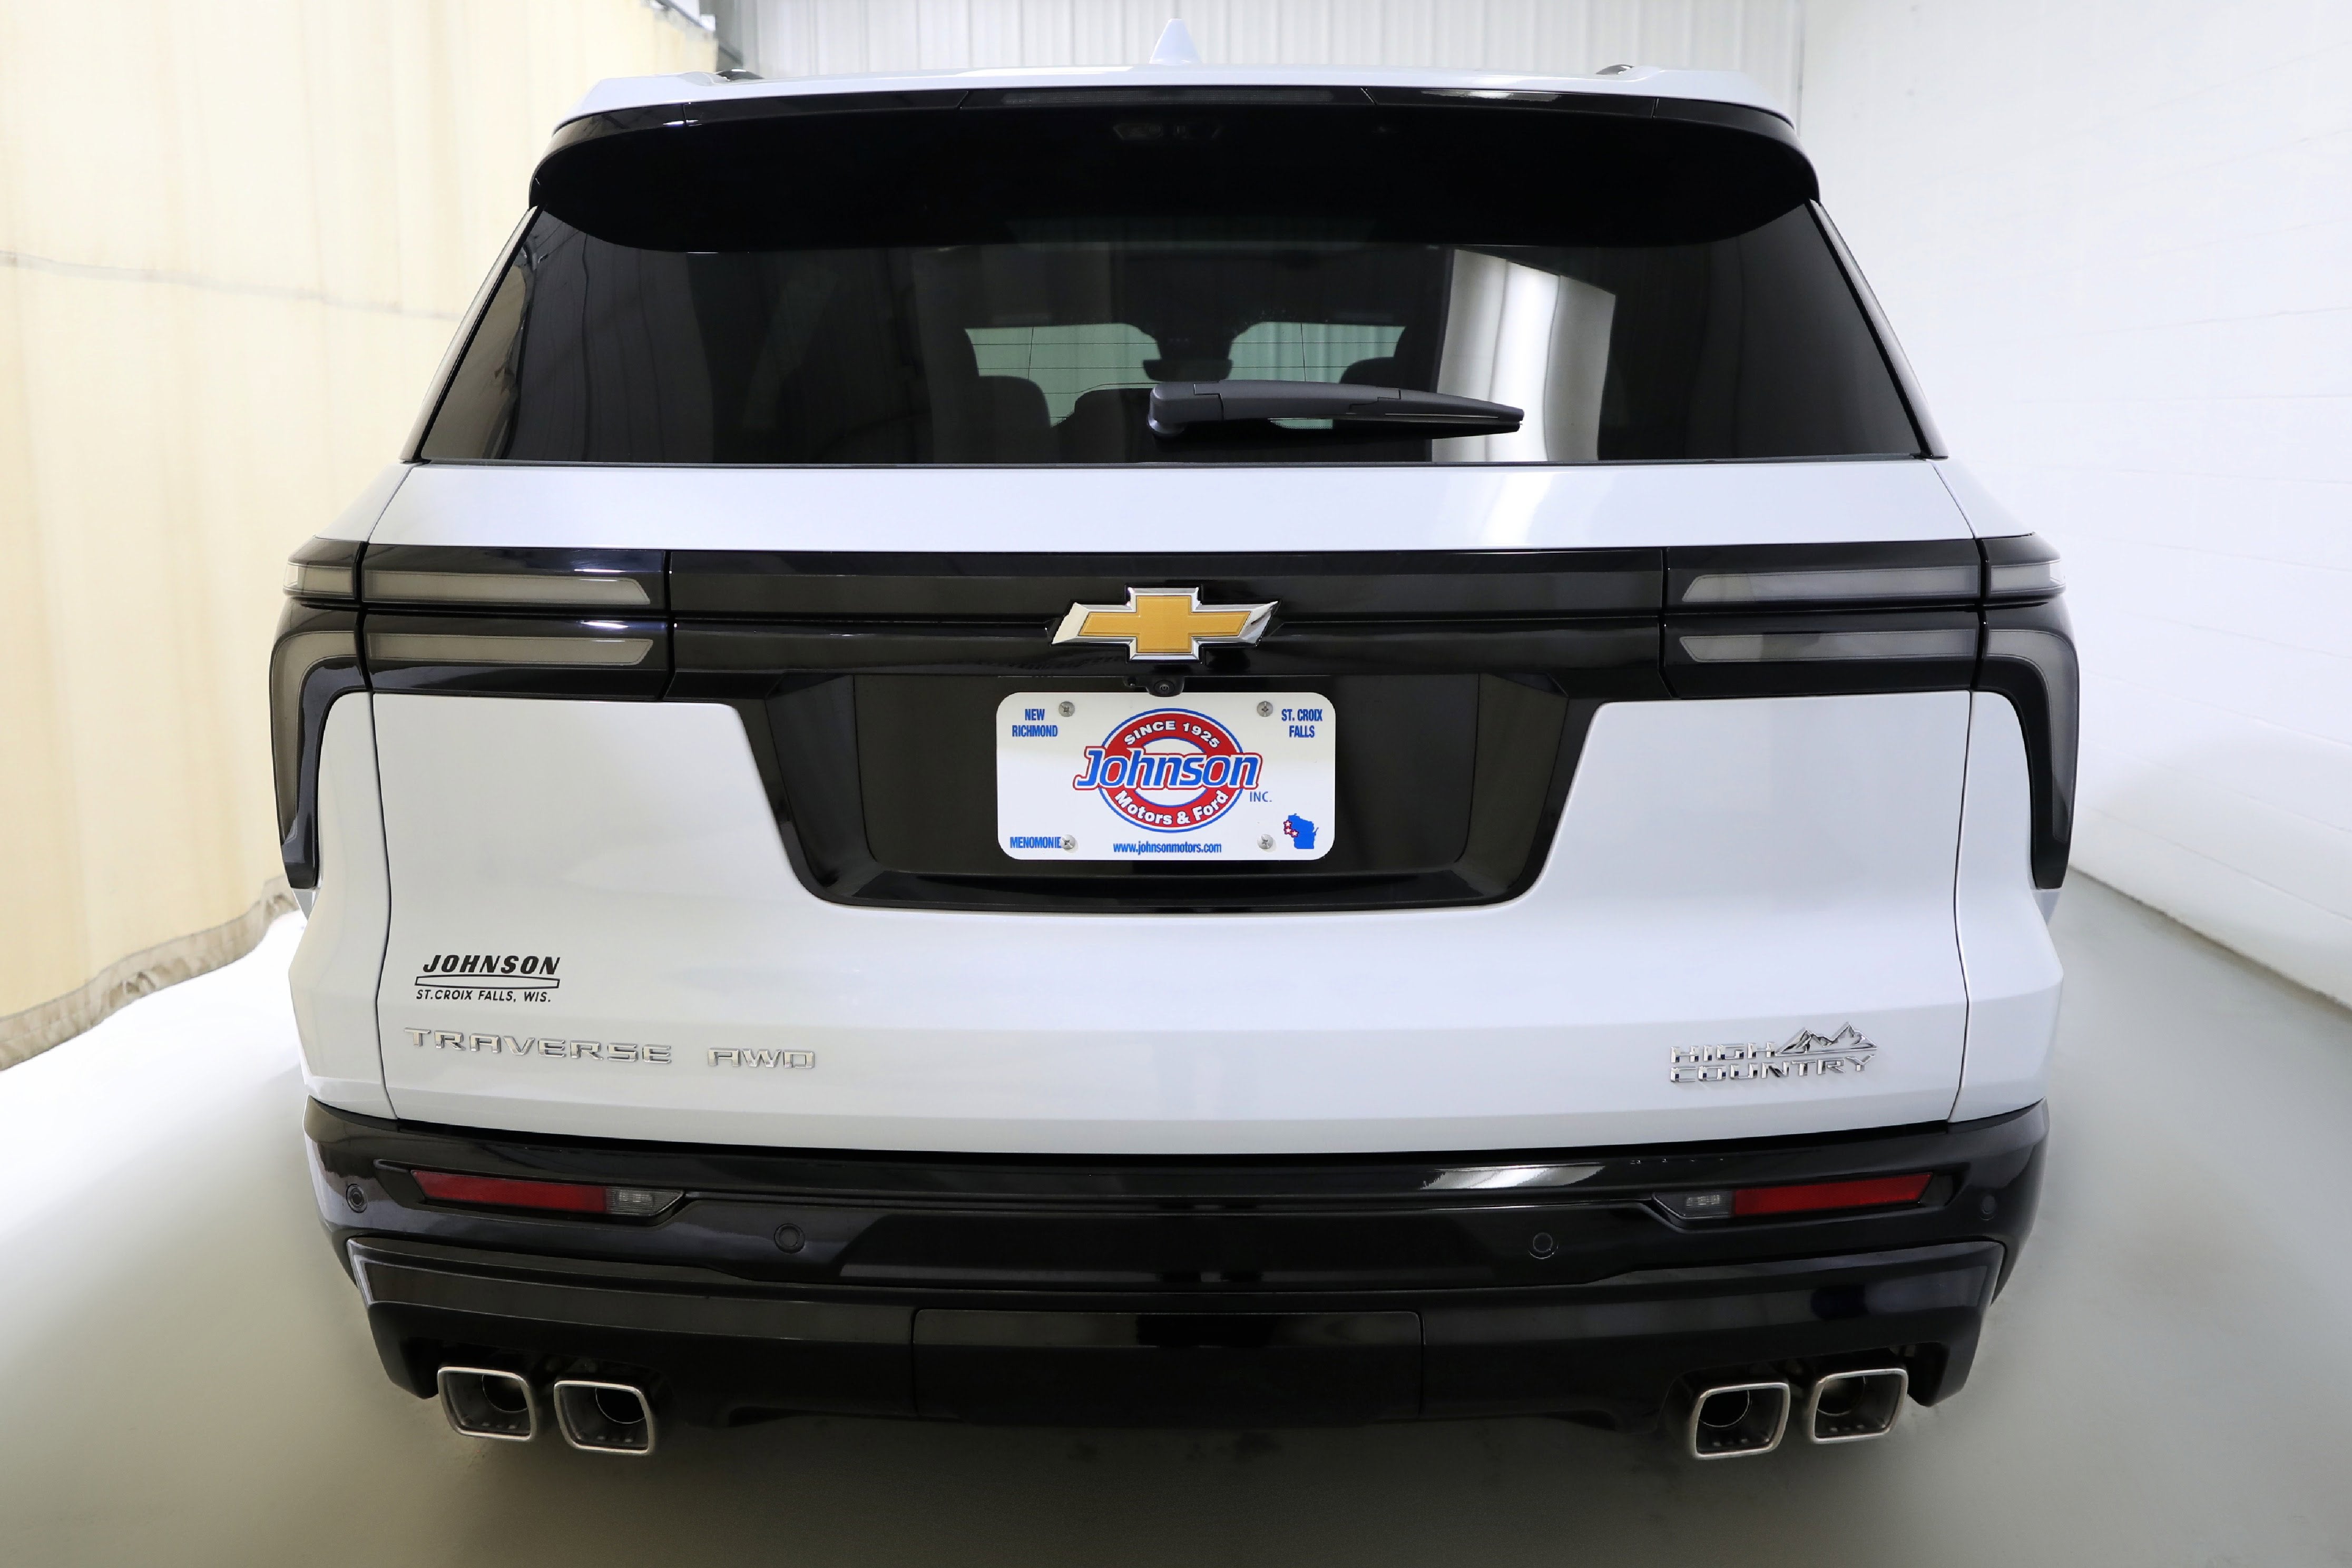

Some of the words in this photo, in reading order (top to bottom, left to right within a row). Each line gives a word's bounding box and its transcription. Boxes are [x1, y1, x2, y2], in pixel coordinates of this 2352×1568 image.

[1025, 709, 1045, 721] NEW
[1281, 709, 1295, 721] ST.
[1297, 709, 1322, 721] CROIX
[1012, 724, 1058, 737] RICHMOND
[1124, 720, 1176, 746] SINCE
[1182, 722, 1220, 748] 1925
[1289, 725, 1315, 738] FALLS
[1073, 746, 1263, 790] Johnson
[1250, 791, 1272, 802] INC.
[1114, 790, 1172, 825] Motors
[1177, 810, 1191, 825] &
[1192, 790, 1229, 821] Ford
[1010, 836, 1063, 849] MENOMONIE
[1113, 840, 1222, 855] www.johnsonmotors.com
[423, 954, 560, 975] JOHNSON
[477, 991, 516, 1003] FALLS,
[524, 991, 551, 1003] WIS.
[404, 1027, 672, 1063] TRAVERSE
[707, 1046, 815, 1069] AWD
[1671, 1041, 1776, 1063] HIGH
[1670, 1054, 1876, 1082] COUNTRY
